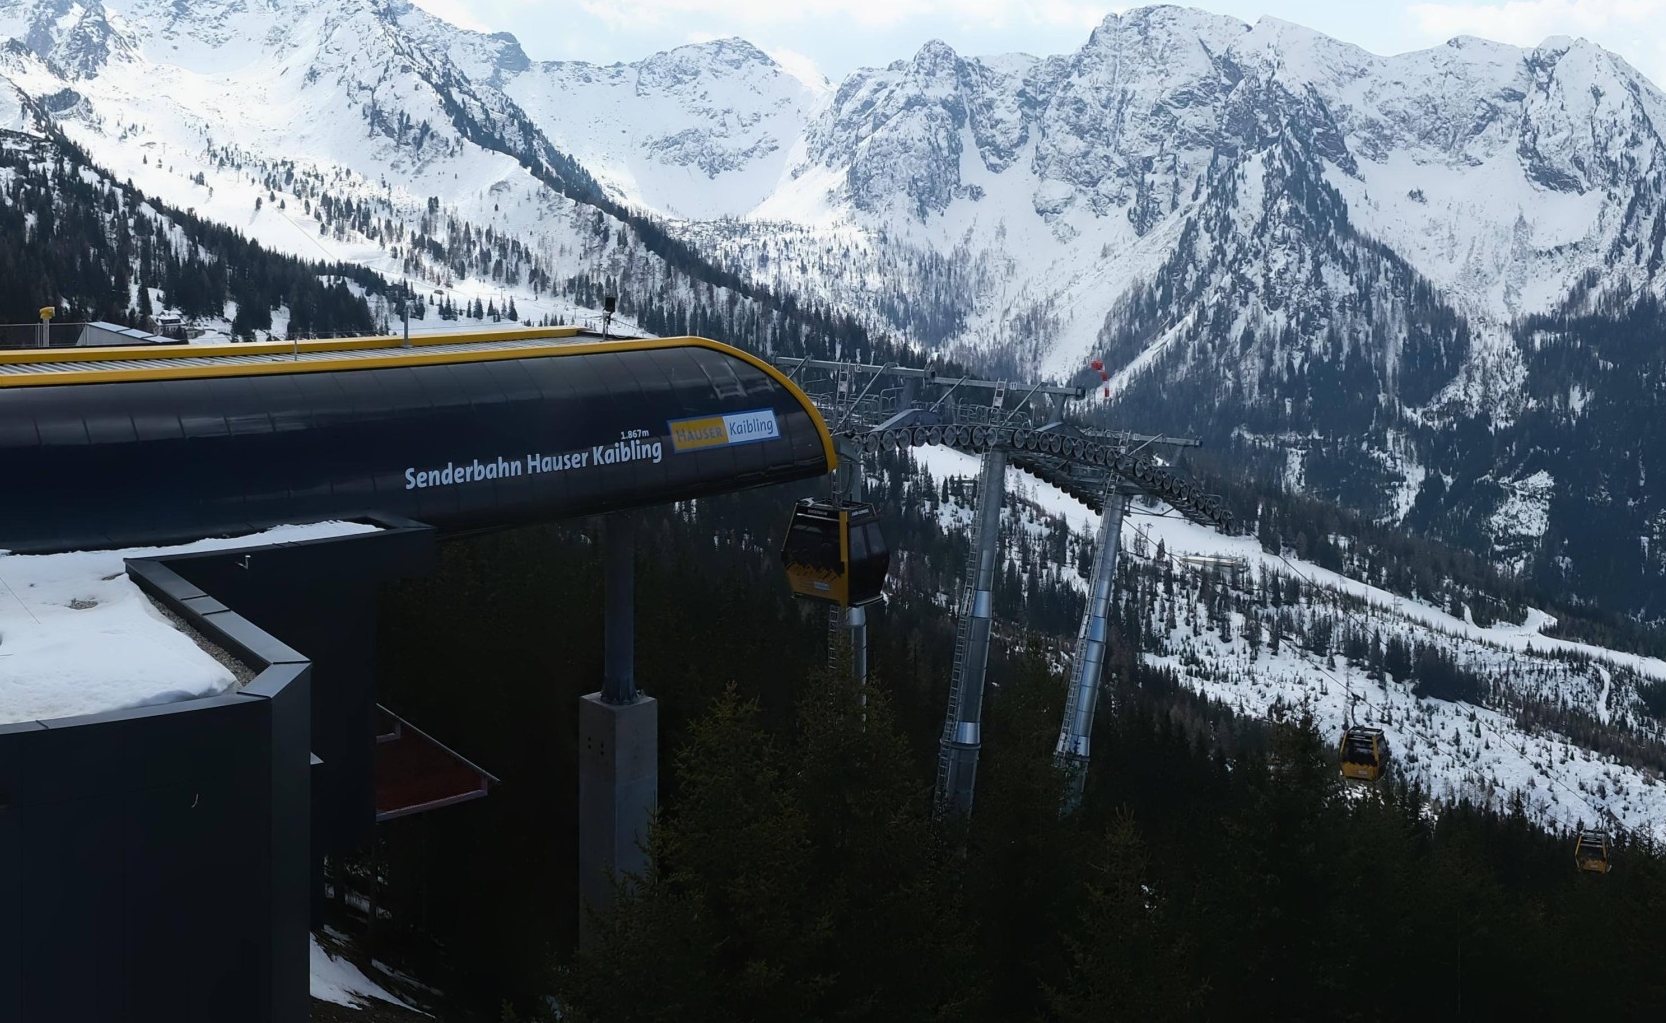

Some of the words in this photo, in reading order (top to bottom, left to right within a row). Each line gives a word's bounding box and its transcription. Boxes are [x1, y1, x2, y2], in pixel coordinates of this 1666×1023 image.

[620, 429, 650, 440] 1.867m
[675, 426, 723, 443] HAUSER
[729, 416, 774, 437] Kaibling
[404, 455, 522, 490] Senderbahn
[527, 449, 589, 475] Hauser
[592, 439, 663, 465] Kaibling
